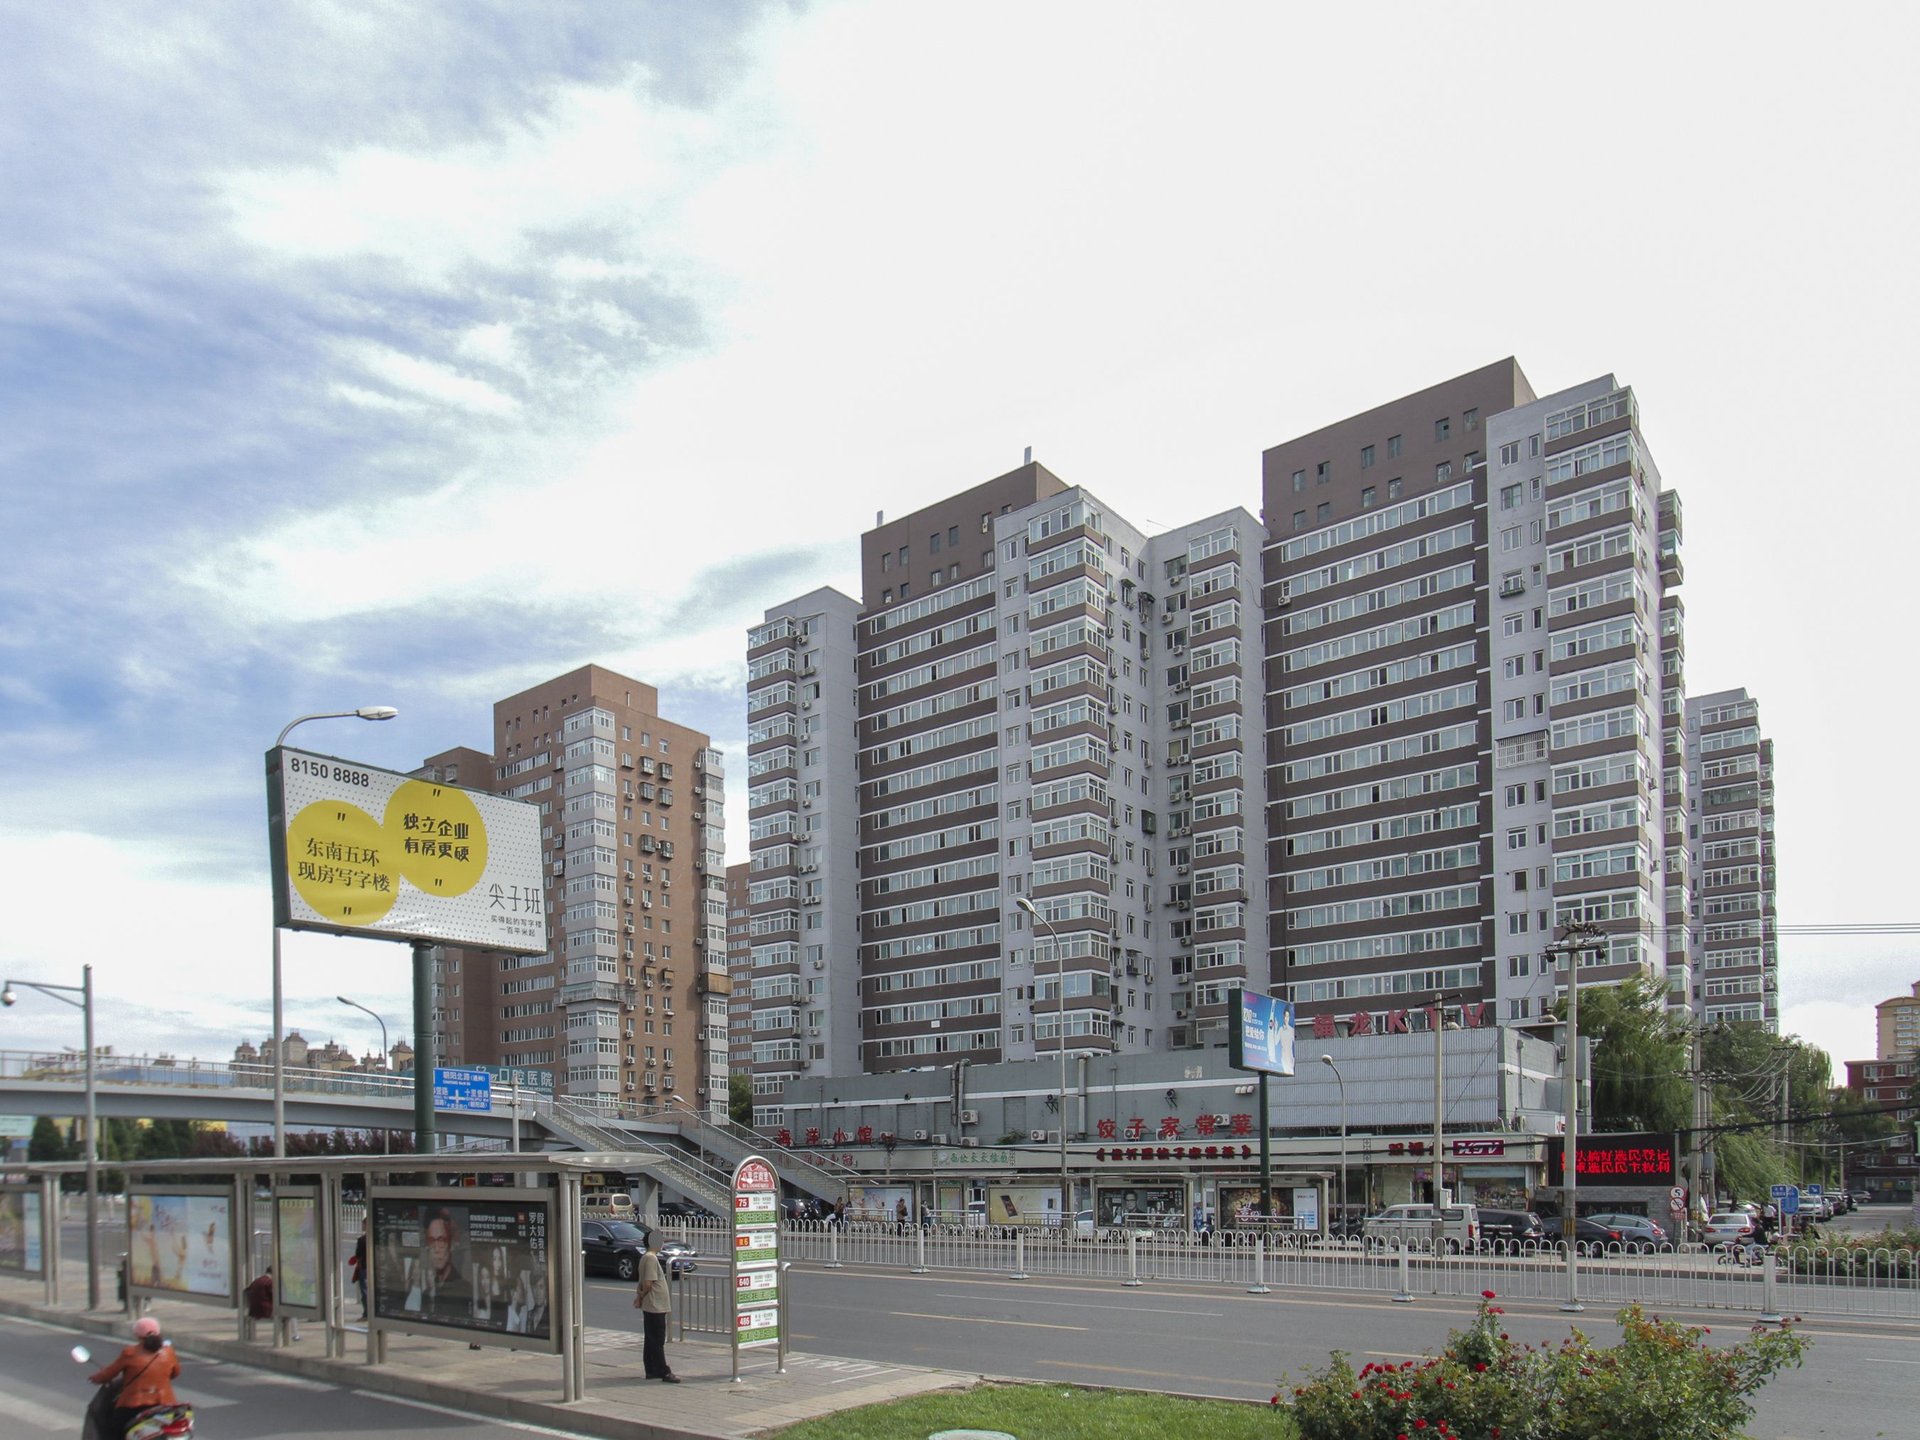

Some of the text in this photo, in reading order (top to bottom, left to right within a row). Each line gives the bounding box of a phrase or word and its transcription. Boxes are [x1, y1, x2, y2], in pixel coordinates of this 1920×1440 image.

[291, 757, 370, 787] 8150 8888
[403, 812, 470, 840] 独立企业
[306, 838, 380, 867] 东南五环
[404, 837, 470, 862] 有房更硬
[298, 861, 391, 893] 现房写字楼
[488, 883, 542, 915] 尖子班
[1096, 1114, 1253, 1139] 饺子家常菜
[738, 1198, 748, 1207] 75
[1674, 1188, 1681, 1197] 5
